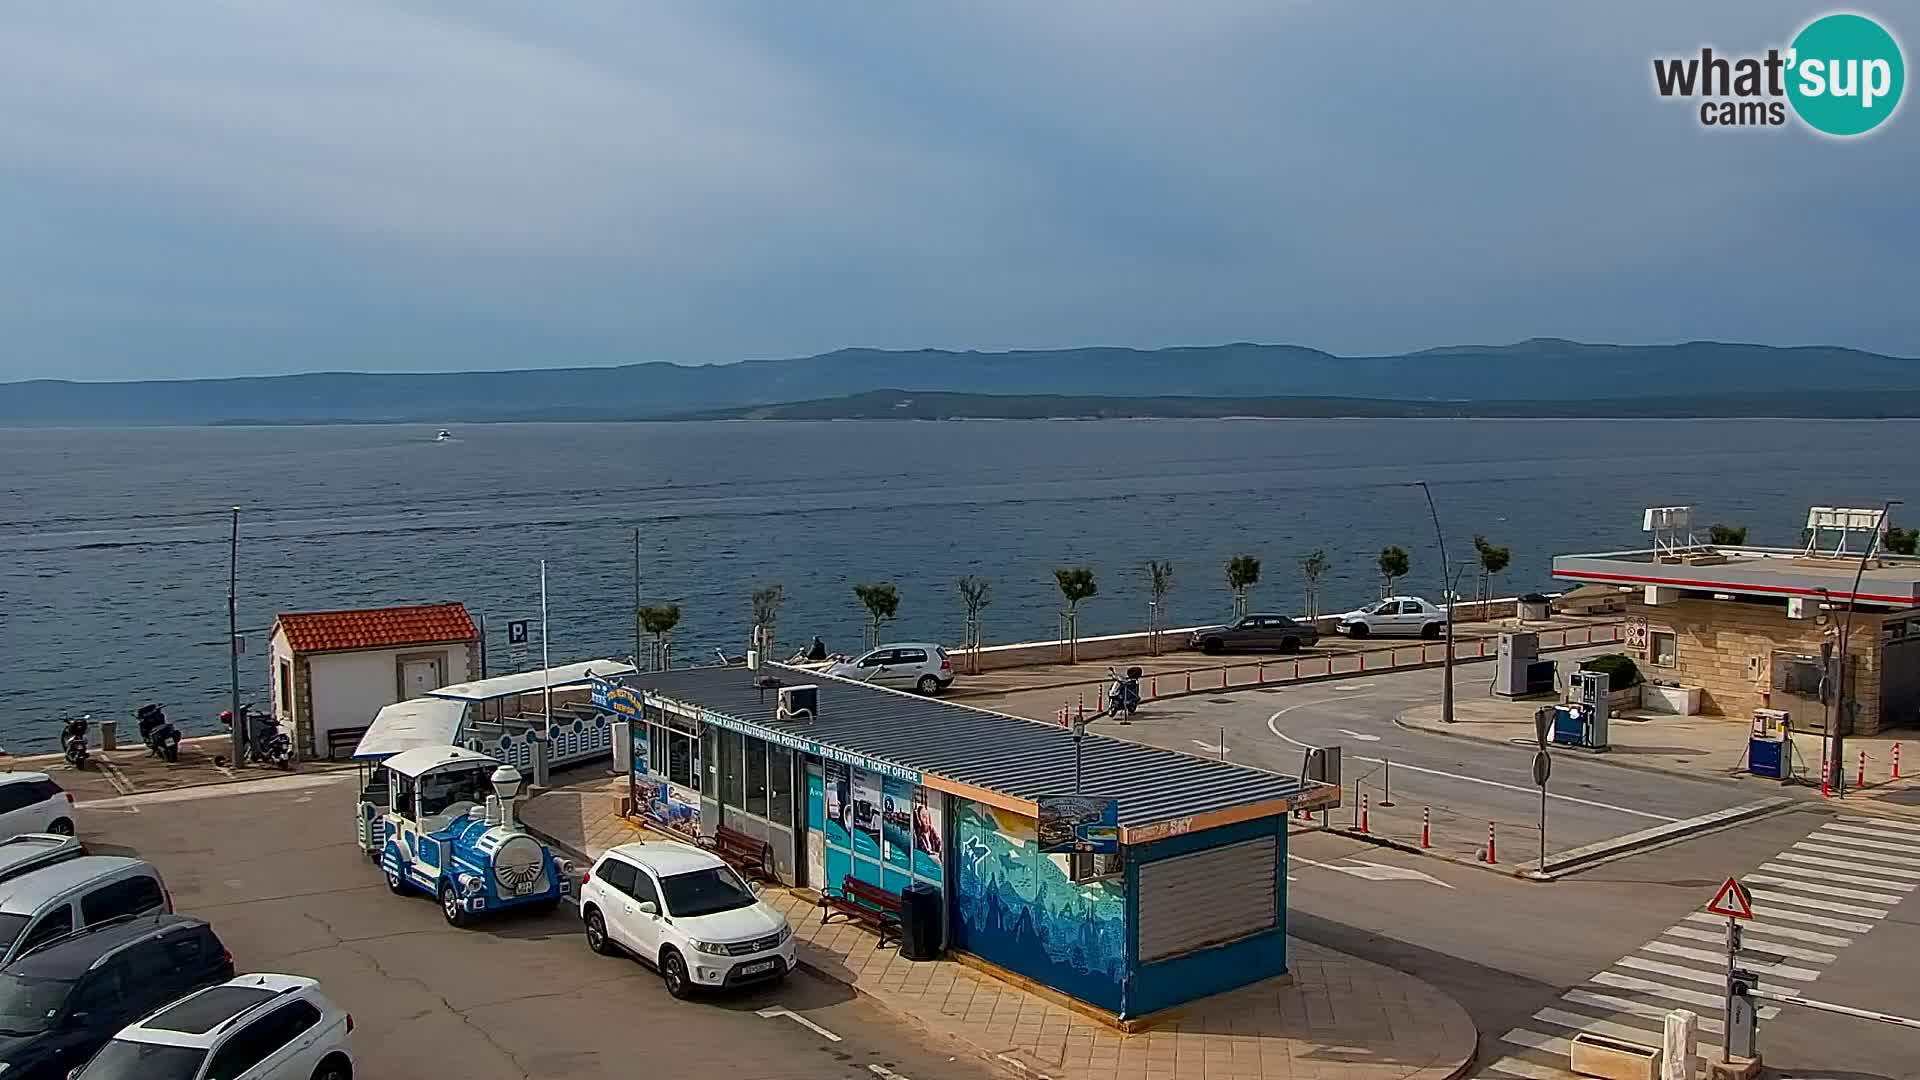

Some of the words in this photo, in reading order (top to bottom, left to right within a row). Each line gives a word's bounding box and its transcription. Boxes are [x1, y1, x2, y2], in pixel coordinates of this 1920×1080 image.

[512, 623, 523, 641] P
[744, 725, 780, 743] AUTOBUSNA
[781, 735, 810, 752] POSTAJA
[820, 747, 834, 758] BUS
[834, 751, 865, 767] STATION
[866, 759, 892, 775] TICKET
[892, 766, 918, 782] OFFICE
